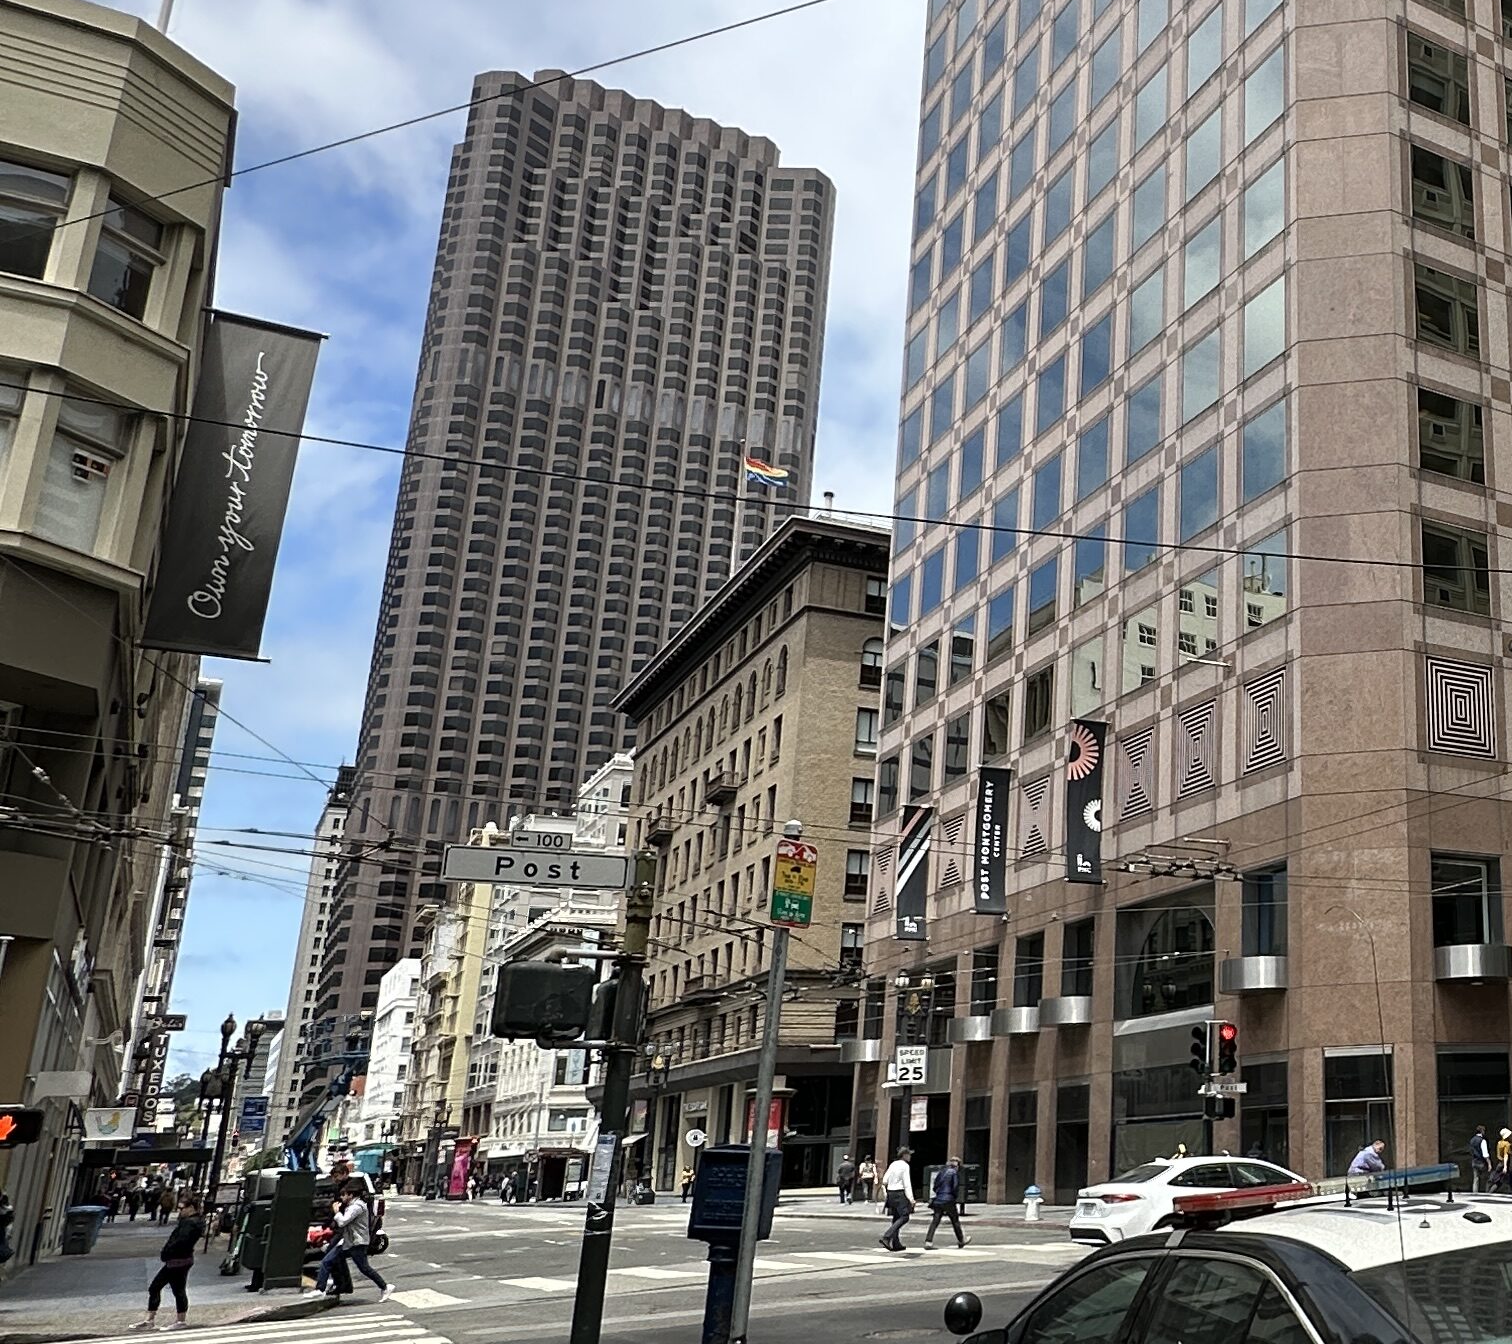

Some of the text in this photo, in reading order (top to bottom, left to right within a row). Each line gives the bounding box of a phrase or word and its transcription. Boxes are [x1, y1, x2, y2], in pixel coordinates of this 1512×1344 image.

[187, 351, 269, 619] Own your tomorrow
[536, 834, 564, 848] 100
[980, 780, 994, 900] POST MONTGOMERY
[993, 824, 1001, 858] CENTER
[494, 856, 581, 880] Post
[143, 1034, 168, 1122] TUXEDOS
[898, 1067, 923, 1081] 25
